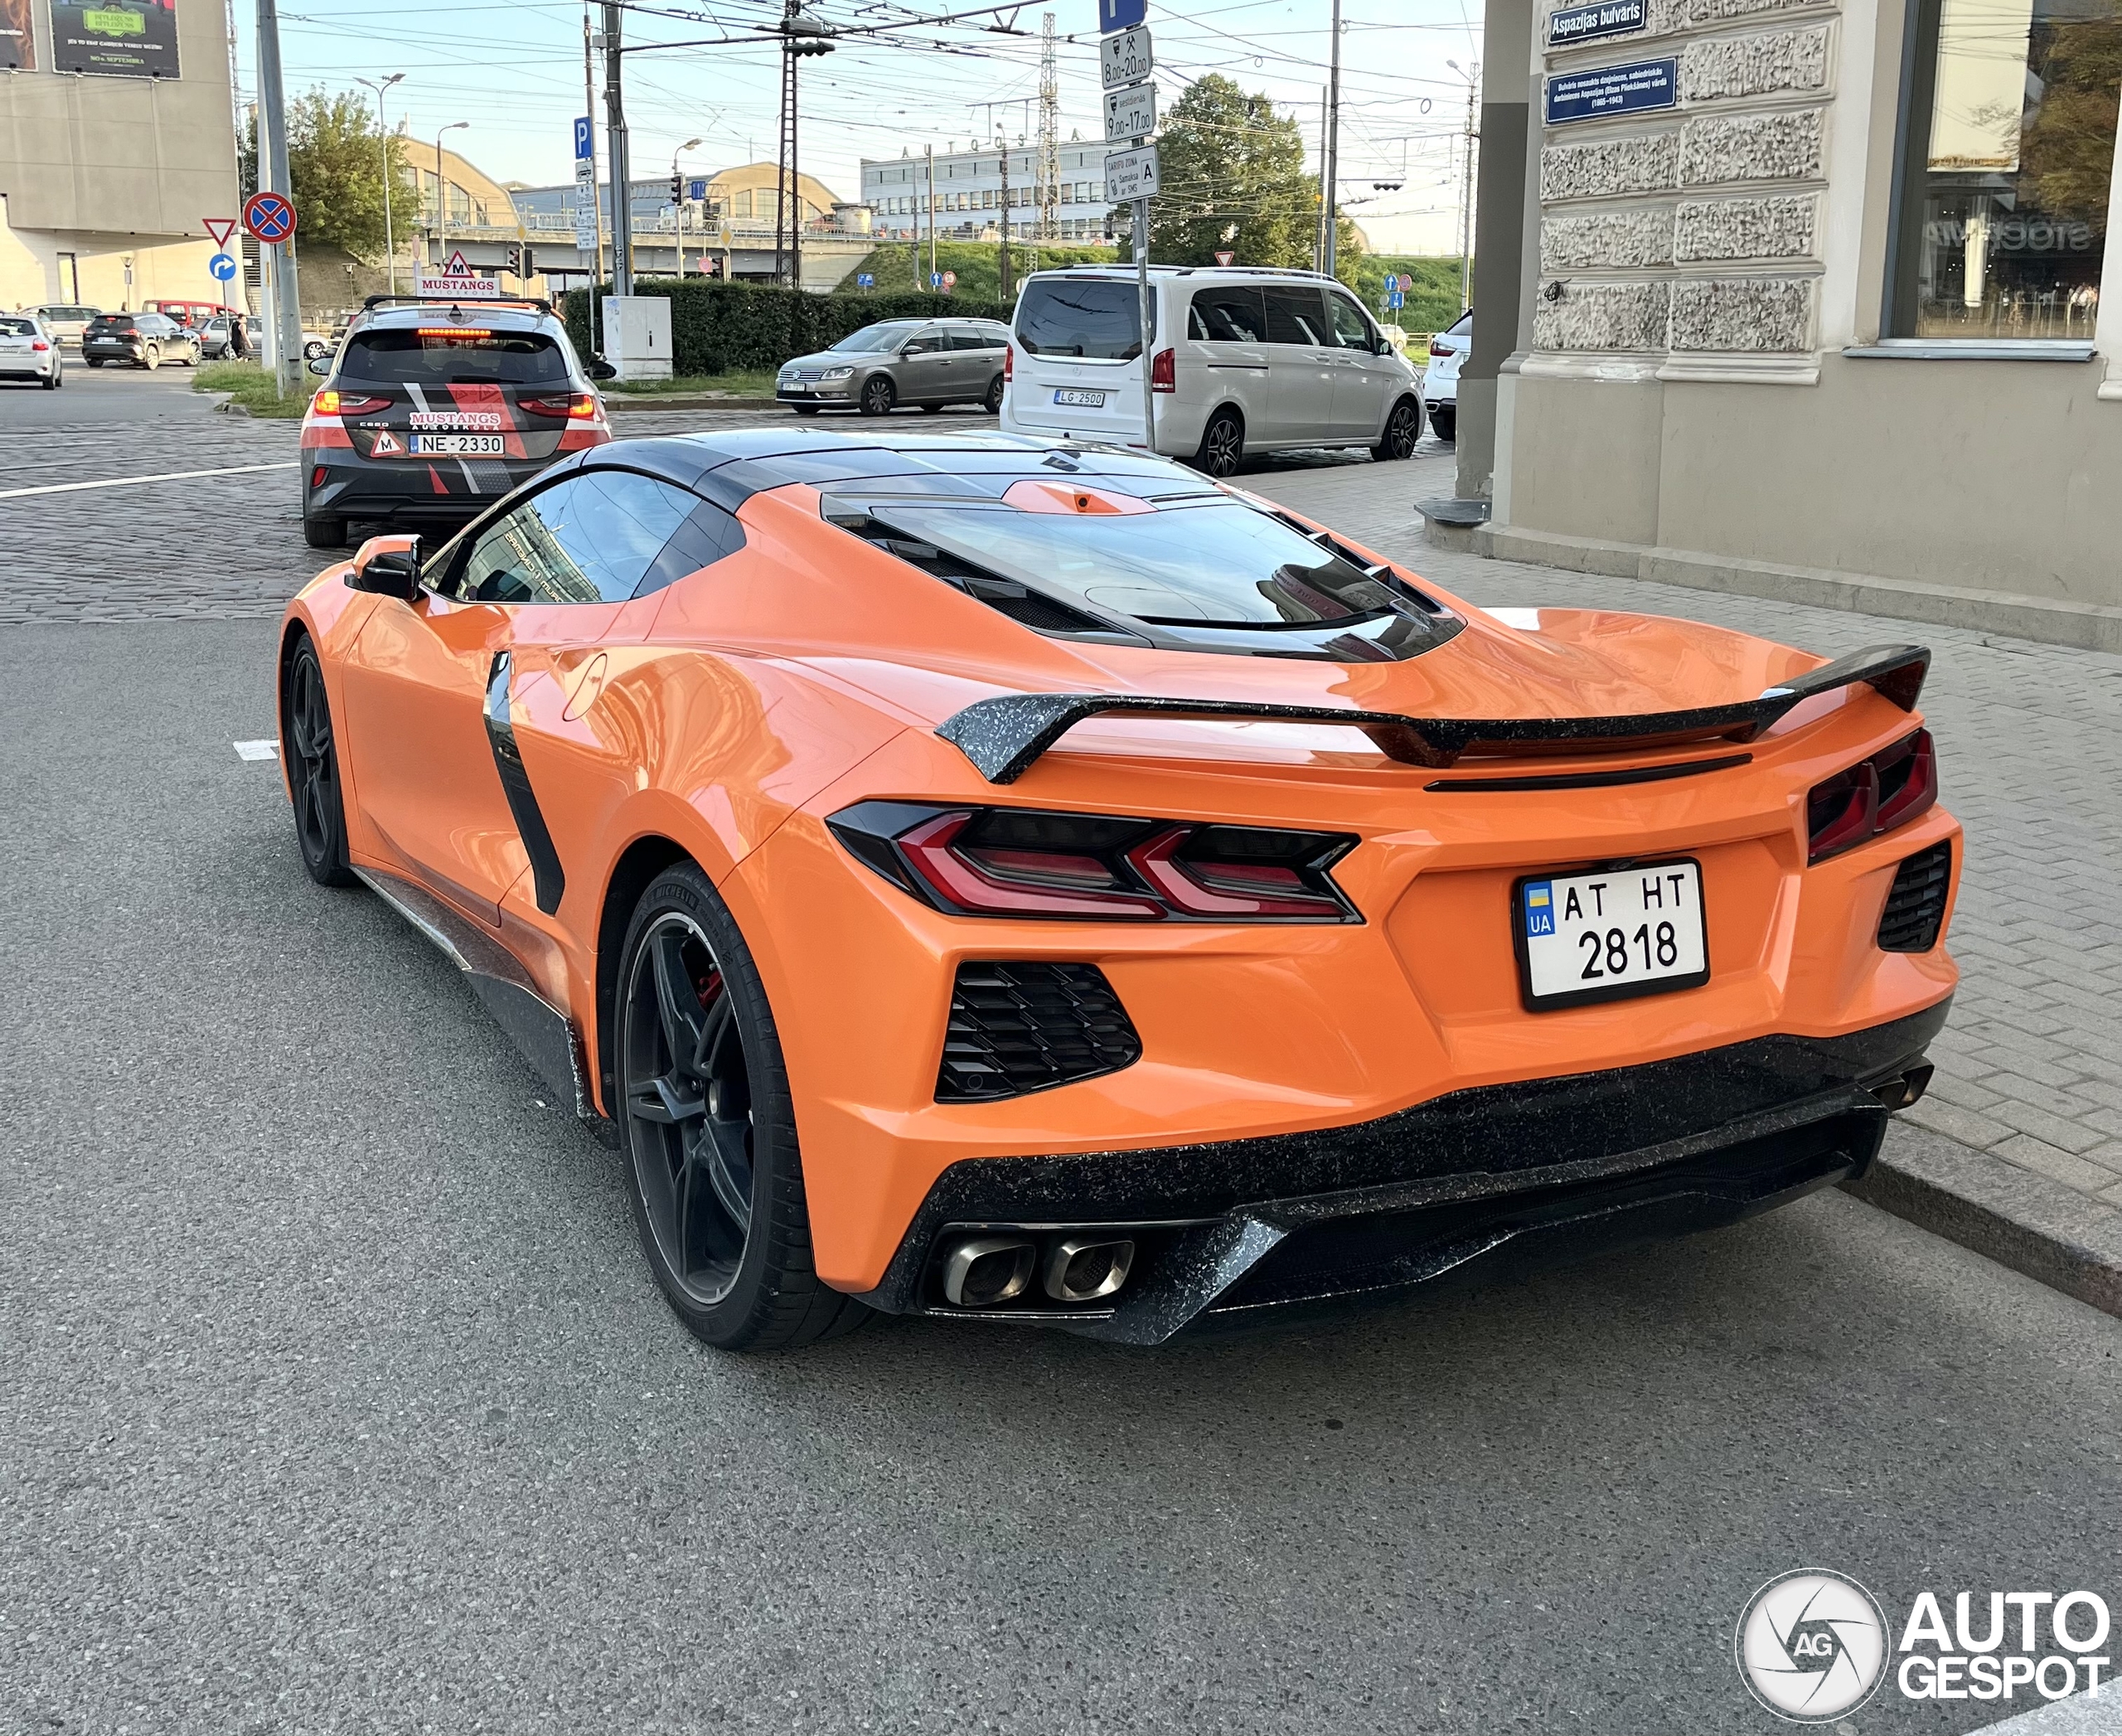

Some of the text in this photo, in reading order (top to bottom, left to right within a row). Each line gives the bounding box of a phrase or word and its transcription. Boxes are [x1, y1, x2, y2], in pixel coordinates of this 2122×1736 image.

[1552, 2, 1640, 36] Aspazijas bulvāris
[577, 123, 588, 154] P
[1144, 163, 1153, 180] A
[453, 264, 464, 274] M
[422, 280, 495, 290] MUSTANGS
[411, 413, 499, 424] MUSTANGS
[380, 439, 392, 452] M
[655, 884, 698, 910] MICHELIN
[1564, 873, 1685, 921] AT HT
[1530, 914, 1552, 933] UA
[1578, 920, 1678, 980] 2818
